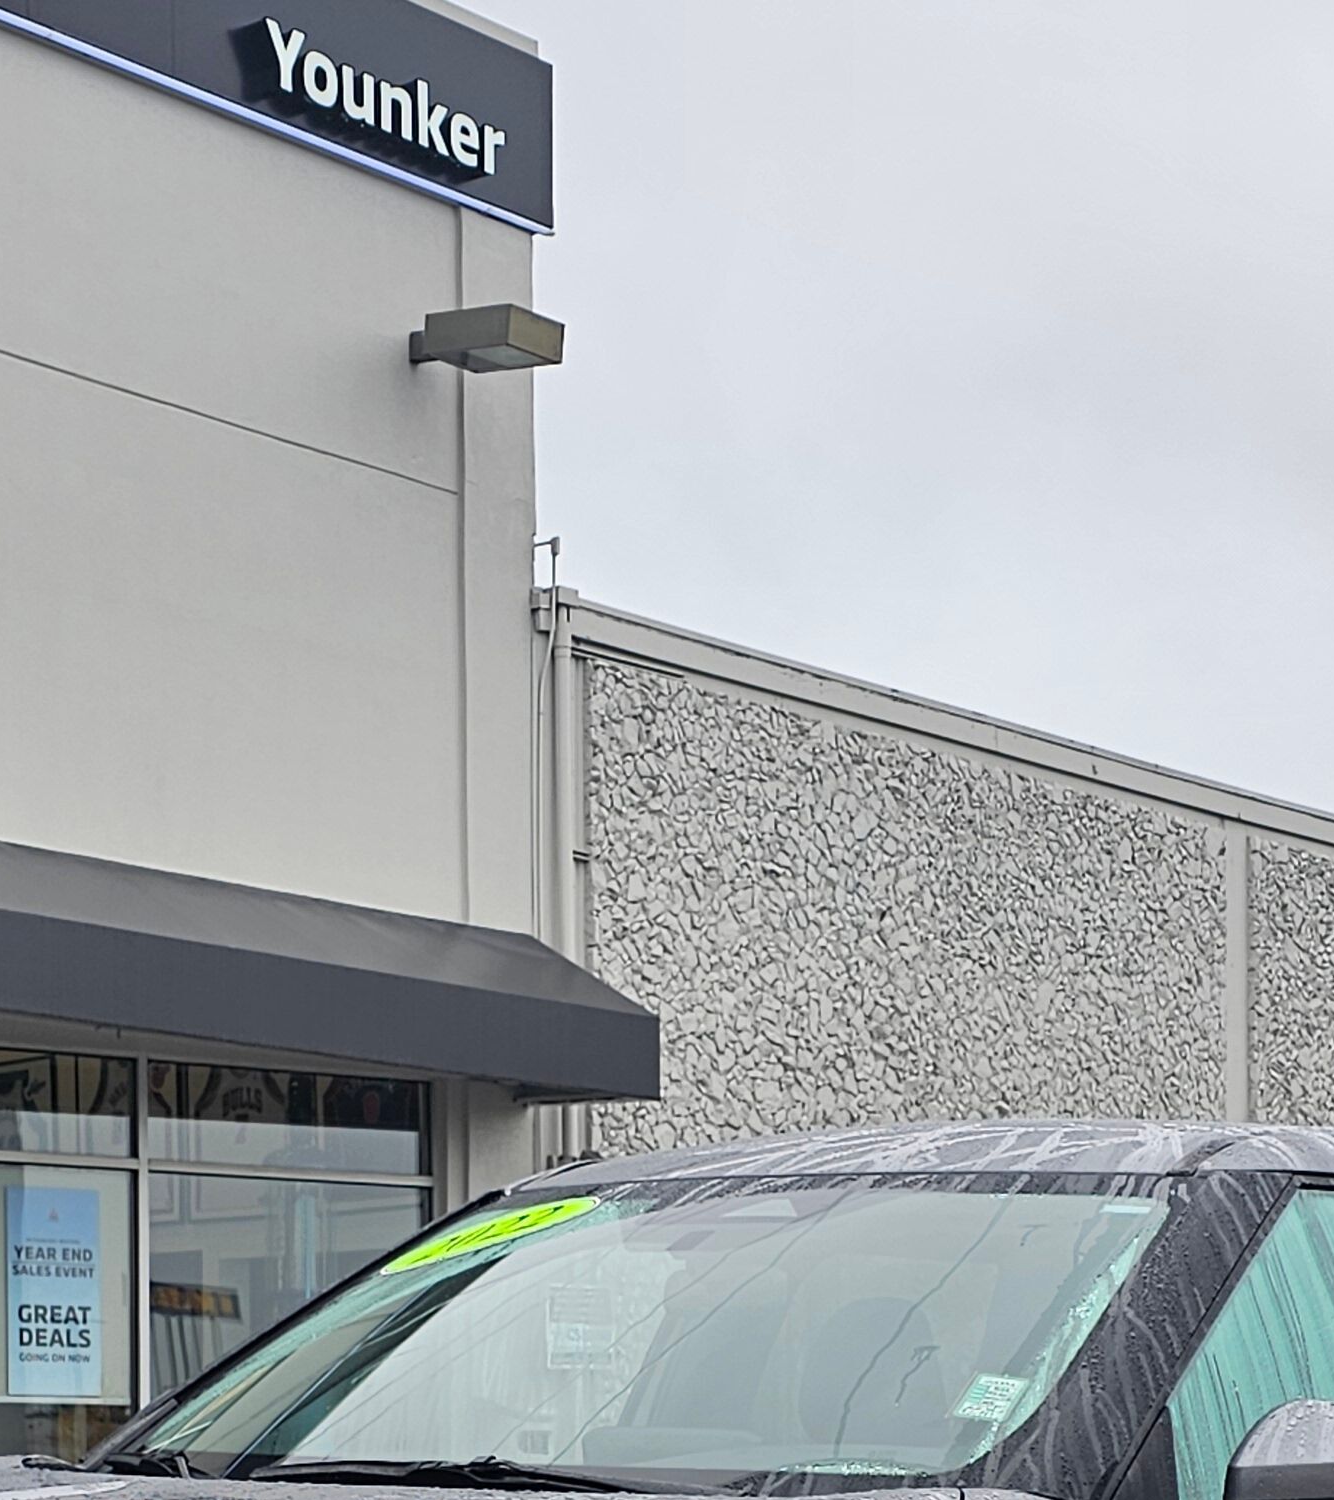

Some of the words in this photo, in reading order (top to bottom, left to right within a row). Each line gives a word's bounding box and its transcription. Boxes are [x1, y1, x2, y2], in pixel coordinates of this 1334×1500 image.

[266, 16, 506, 175] Younker
[13, 1244, 57, 1262] YEAR
[61, 1247, 93, 1262] END
[12, 1264, 52, 1277] SALES
[55, 1266, 95, 1279] EVENT
[17, 1303, 92, 1325] GREAT
[19, 1327, 92, 1349] DEALS
[19, 1351, 50, 1363] GOING
[51, 1352, 66, 1363] ON
[68, 1353, 91, 1364] NOW
